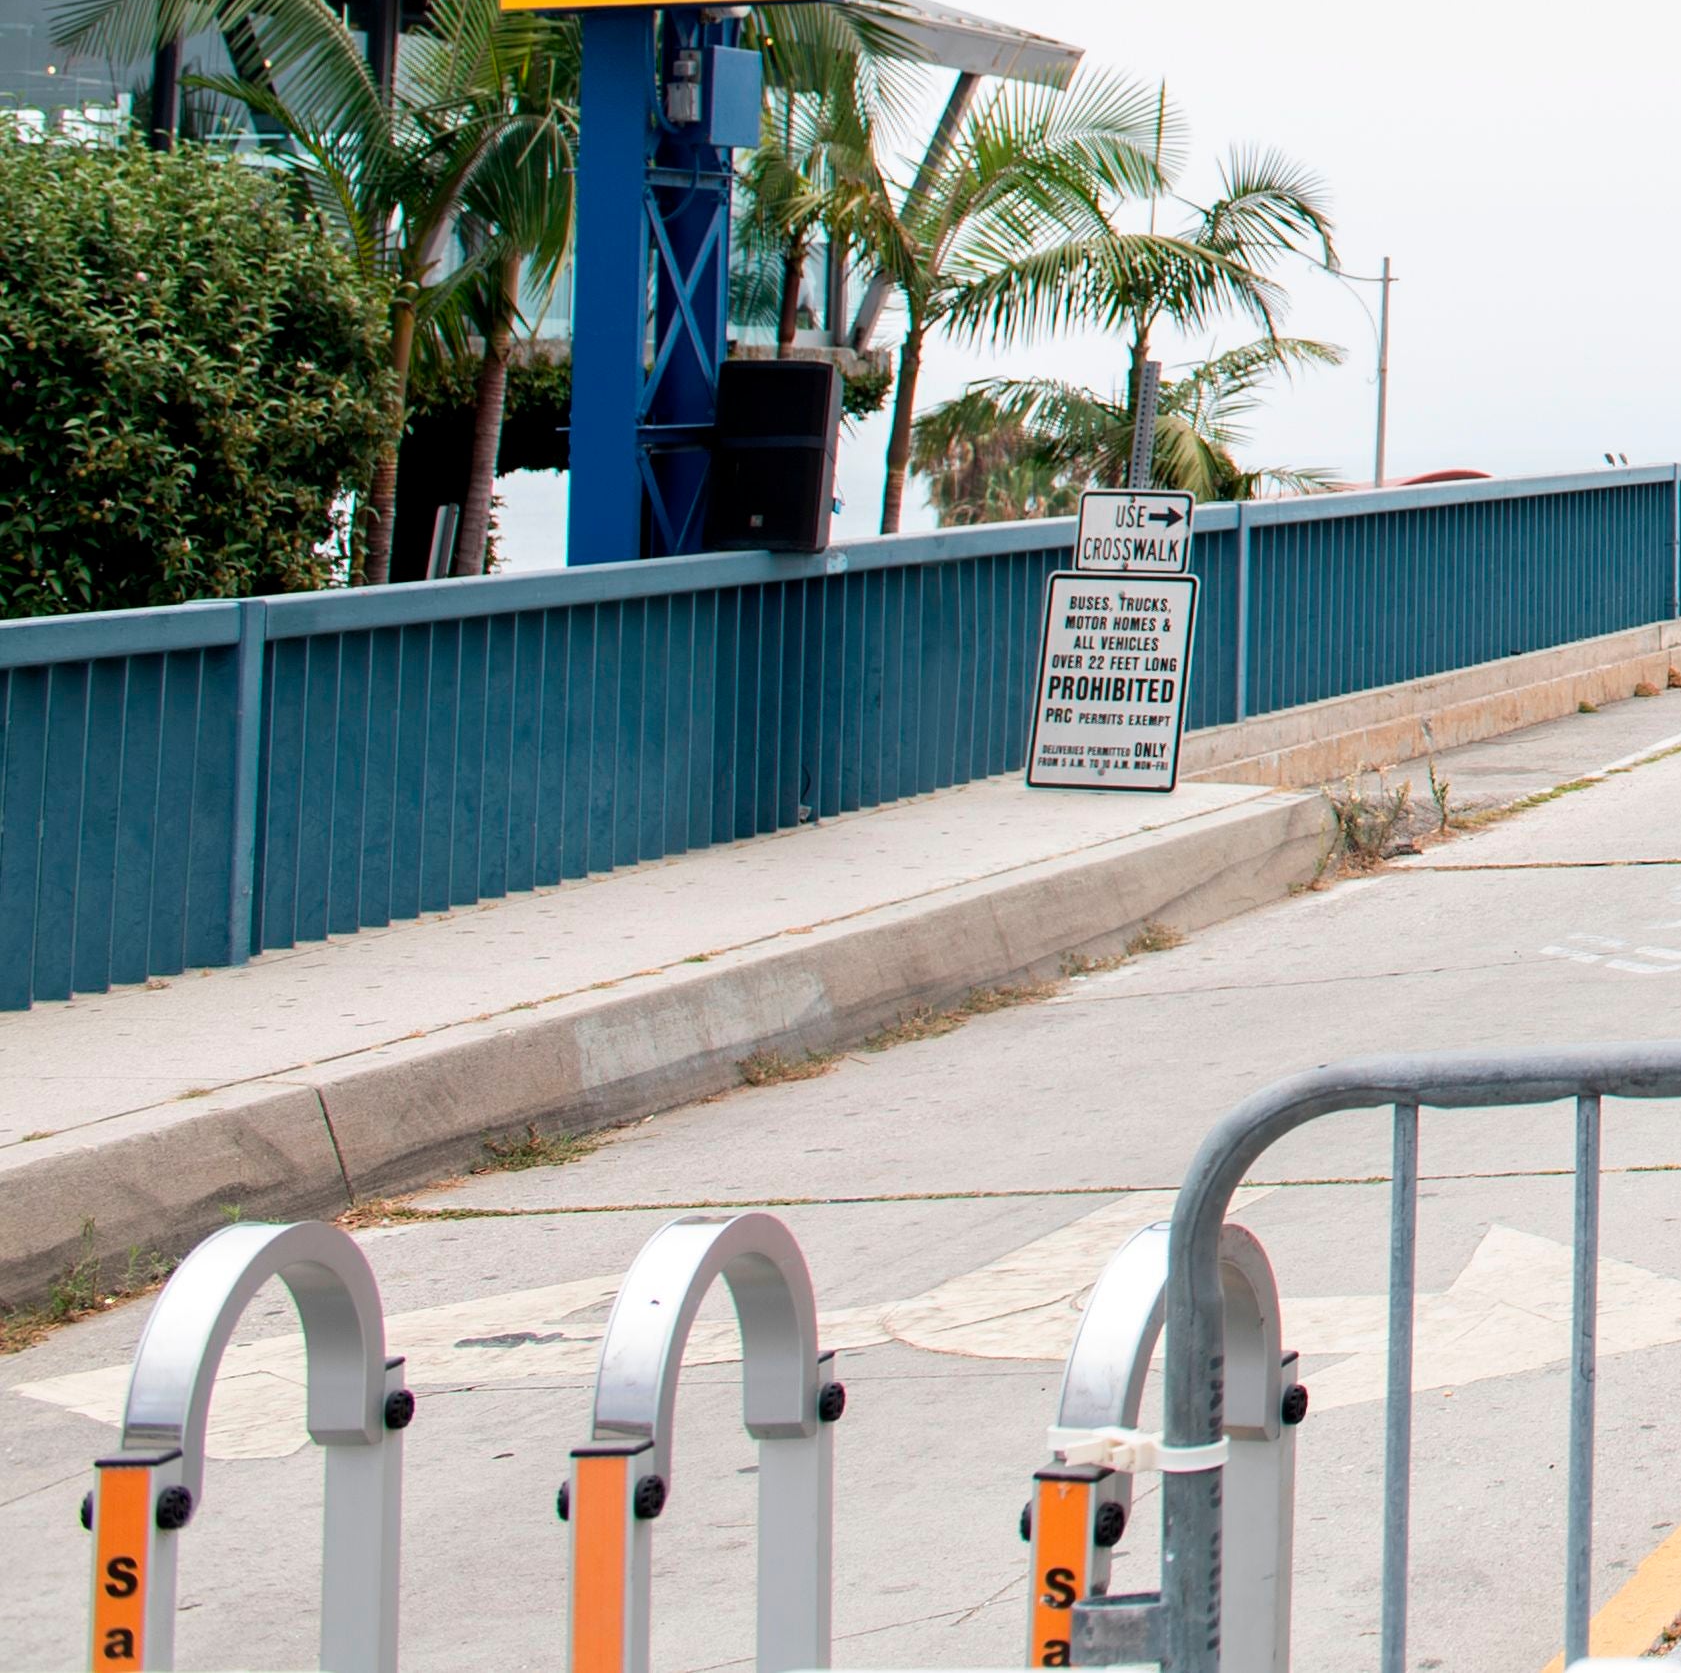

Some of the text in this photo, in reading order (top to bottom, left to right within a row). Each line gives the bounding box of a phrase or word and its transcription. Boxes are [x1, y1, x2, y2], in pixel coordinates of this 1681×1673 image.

[1116, 505, 1147, 528] USE
[1083, 537, 1179, 562] CROSSWALK
[1069, 595, 1171, 613] BUSES, TRUCKS,
[1064, 615, 1171, 632] MOTOR HOMES &
[1073, 635, 1160, 651] ALL VEHICLES
[1051, 654, 1177, 672] OVER 22 FEET LONG
[1047, 676, 1175, 703] PROHIBITED
[1045, 708, 1171, 727] PRC PERMITS EXEMPT
[1042, 742, 1168, 758] DELIVERIES PERMITTED ONLY
[1037, 756, 1059, 767] FROM
[1090, 759, 1099, 768] TO
